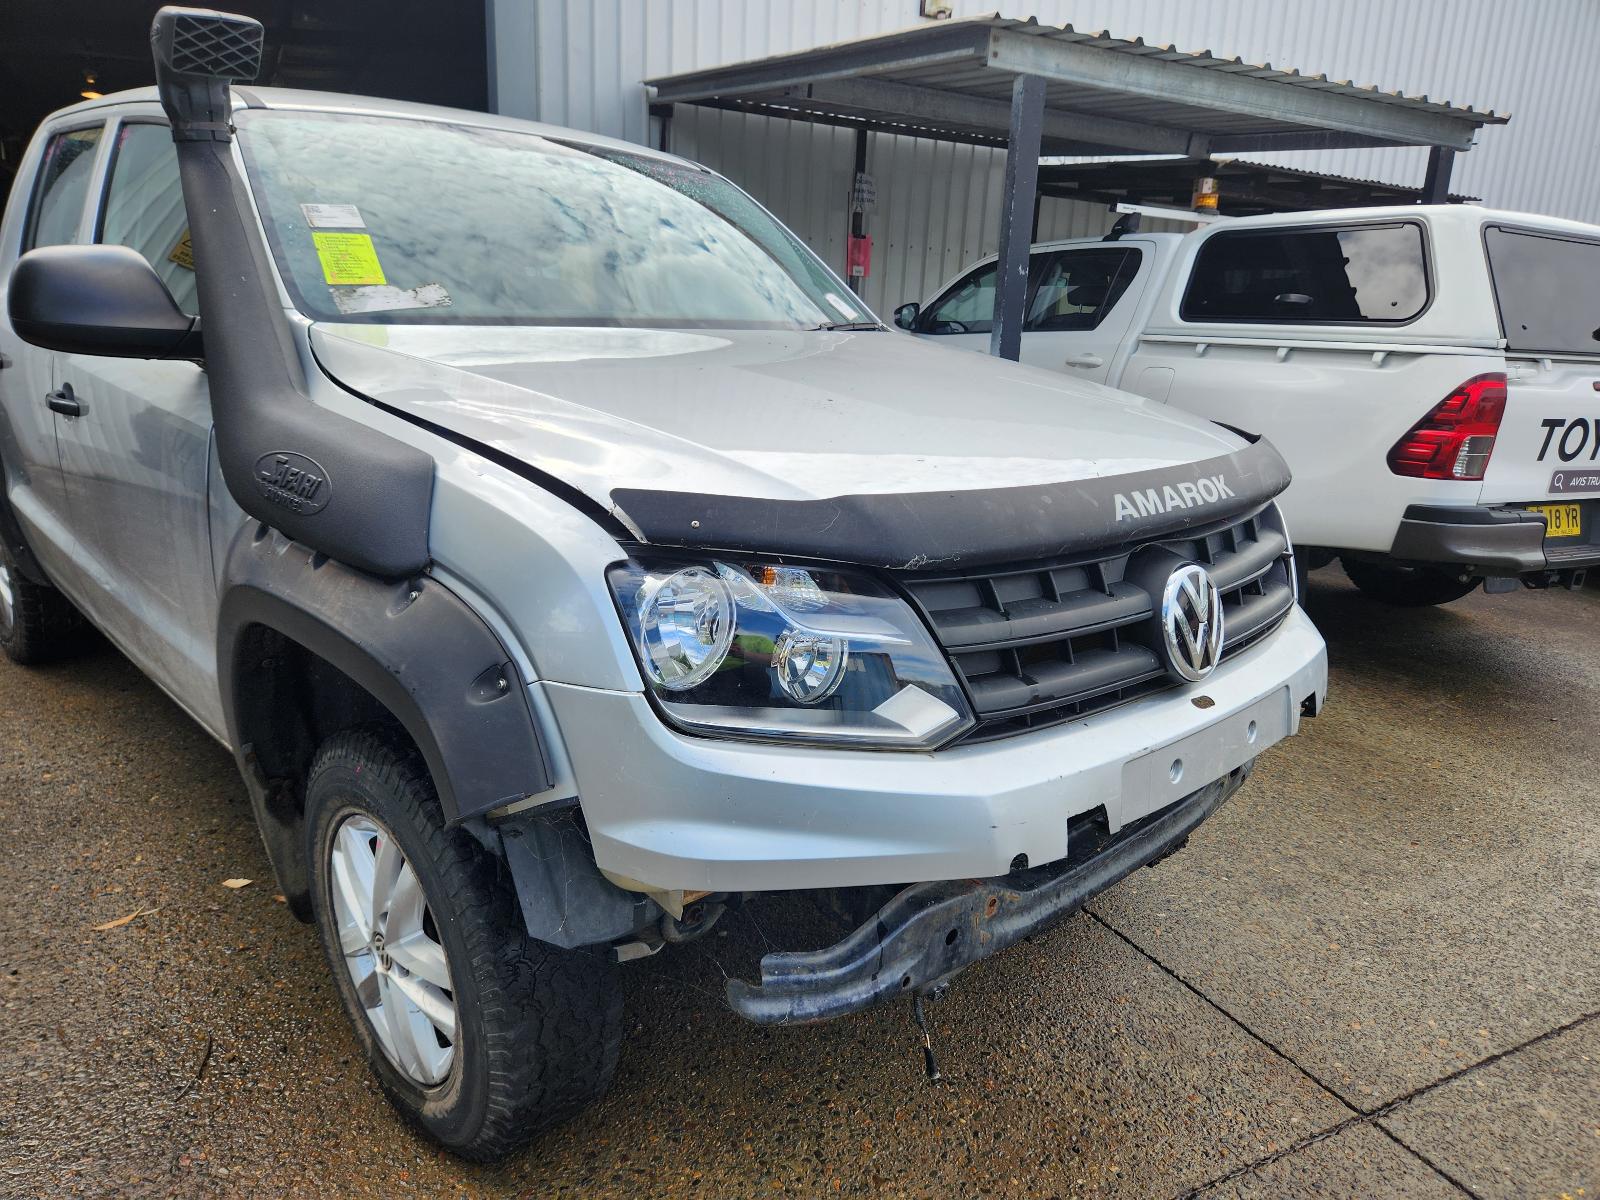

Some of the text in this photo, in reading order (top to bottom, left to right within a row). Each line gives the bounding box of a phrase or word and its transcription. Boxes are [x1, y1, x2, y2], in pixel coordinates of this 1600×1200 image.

[261, 454, 323, 500] SAFARI
[1113, 474, 1236, 522] AMAROK
[1570, 477, 1587, 486] AVIS
